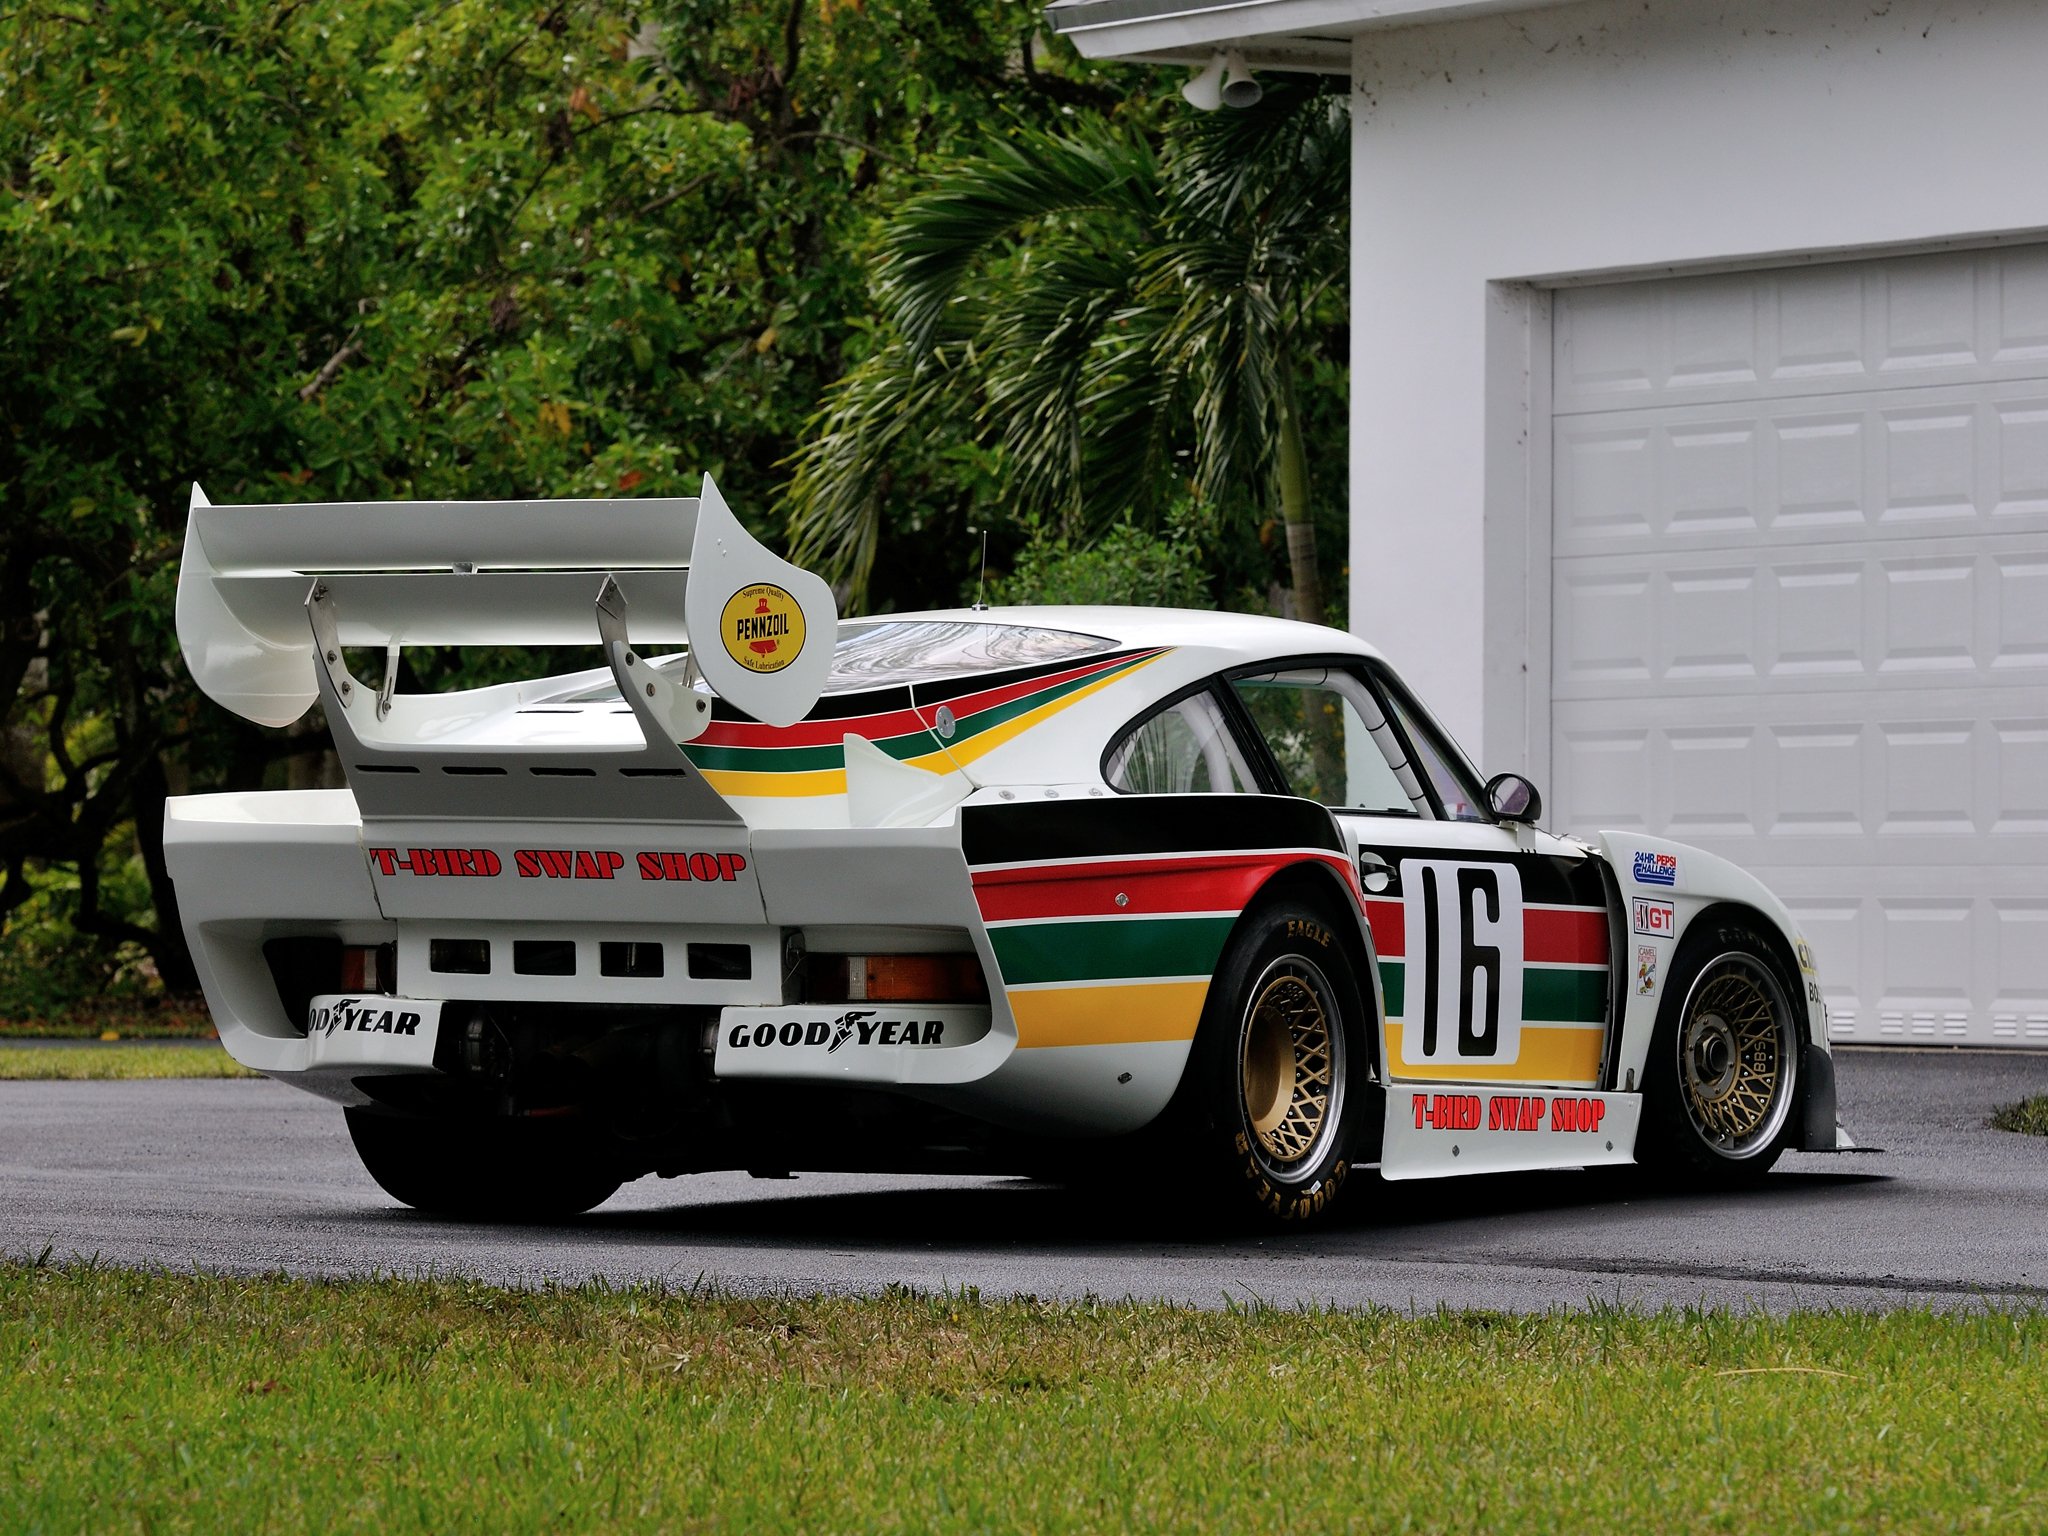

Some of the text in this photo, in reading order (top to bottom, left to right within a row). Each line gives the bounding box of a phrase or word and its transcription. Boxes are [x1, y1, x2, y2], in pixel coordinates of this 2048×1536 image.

[743, 587, 785, 601] Supreme Quality
[737, 613, 789, 641] PENNZOIL
[744, 656, 785, 669] Safe Lubrication
[369, 848, 747, 882] T-BIRD SWAP SHOP
[1633, 863, 1676, 879] CHALLENGE
[1656, 854, 1677, 867] PEPSI
[1649, 907, 1672, 929] GT
[1288, 920, 1331, 948] EAGLE
[1421, 866, 1500, 1056] 16
[1753, 1040, 1767, 1072] BBS
[1412, 1094, 1605, 1133] T-BIRD SWAP SHOP
